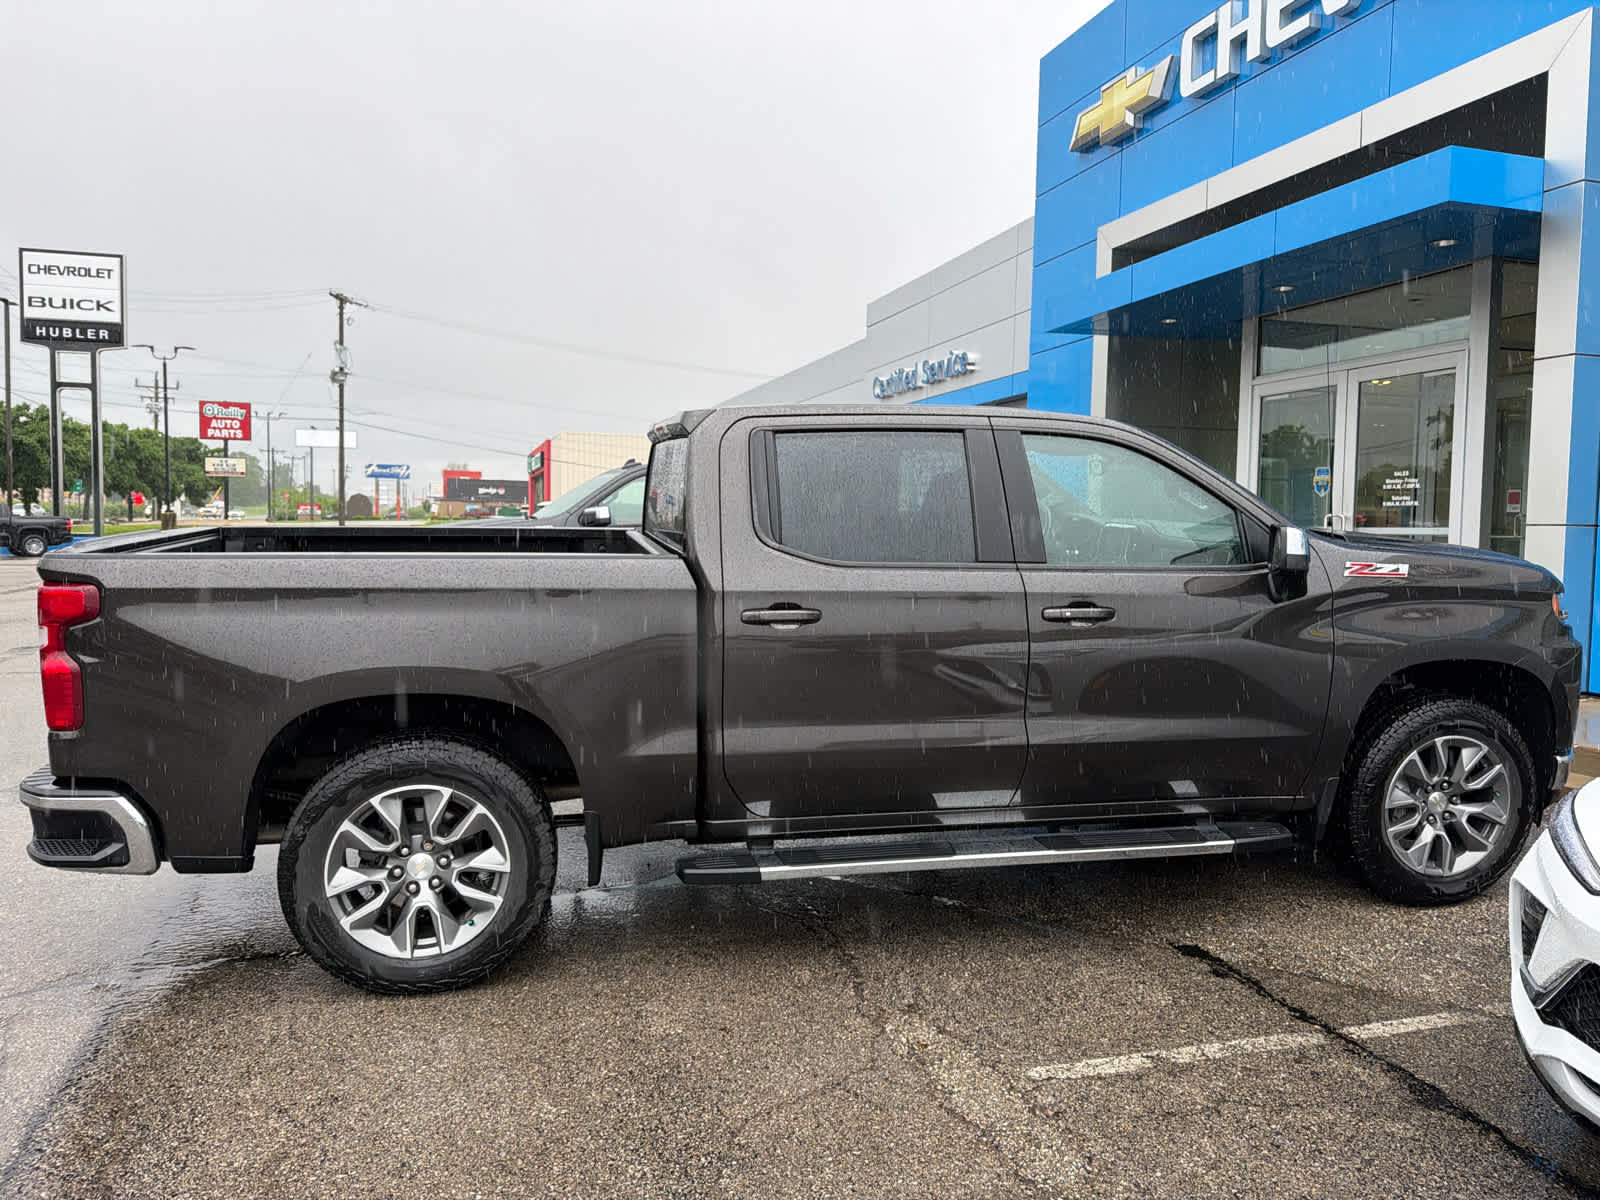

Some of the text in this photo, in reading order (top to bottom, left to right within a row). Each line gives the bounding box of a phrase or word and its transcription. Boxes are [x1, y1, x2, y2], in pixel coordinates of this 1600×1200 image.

[1180, 0, 1358, 98] CHE
[28, 263, 114, 279] CHEVROLET
[28, 296, 115, 312] BUICK
[35, 326, 110, 340] HUBLER
[872, 350, 969, 399] Certified Service
[203, 403, 246, 419] O'Reilly
[210, 419, 241, 429] AUTO
[207, 429, 243, 439] PARTS
[1343, 561, 1409, 577] Z71
